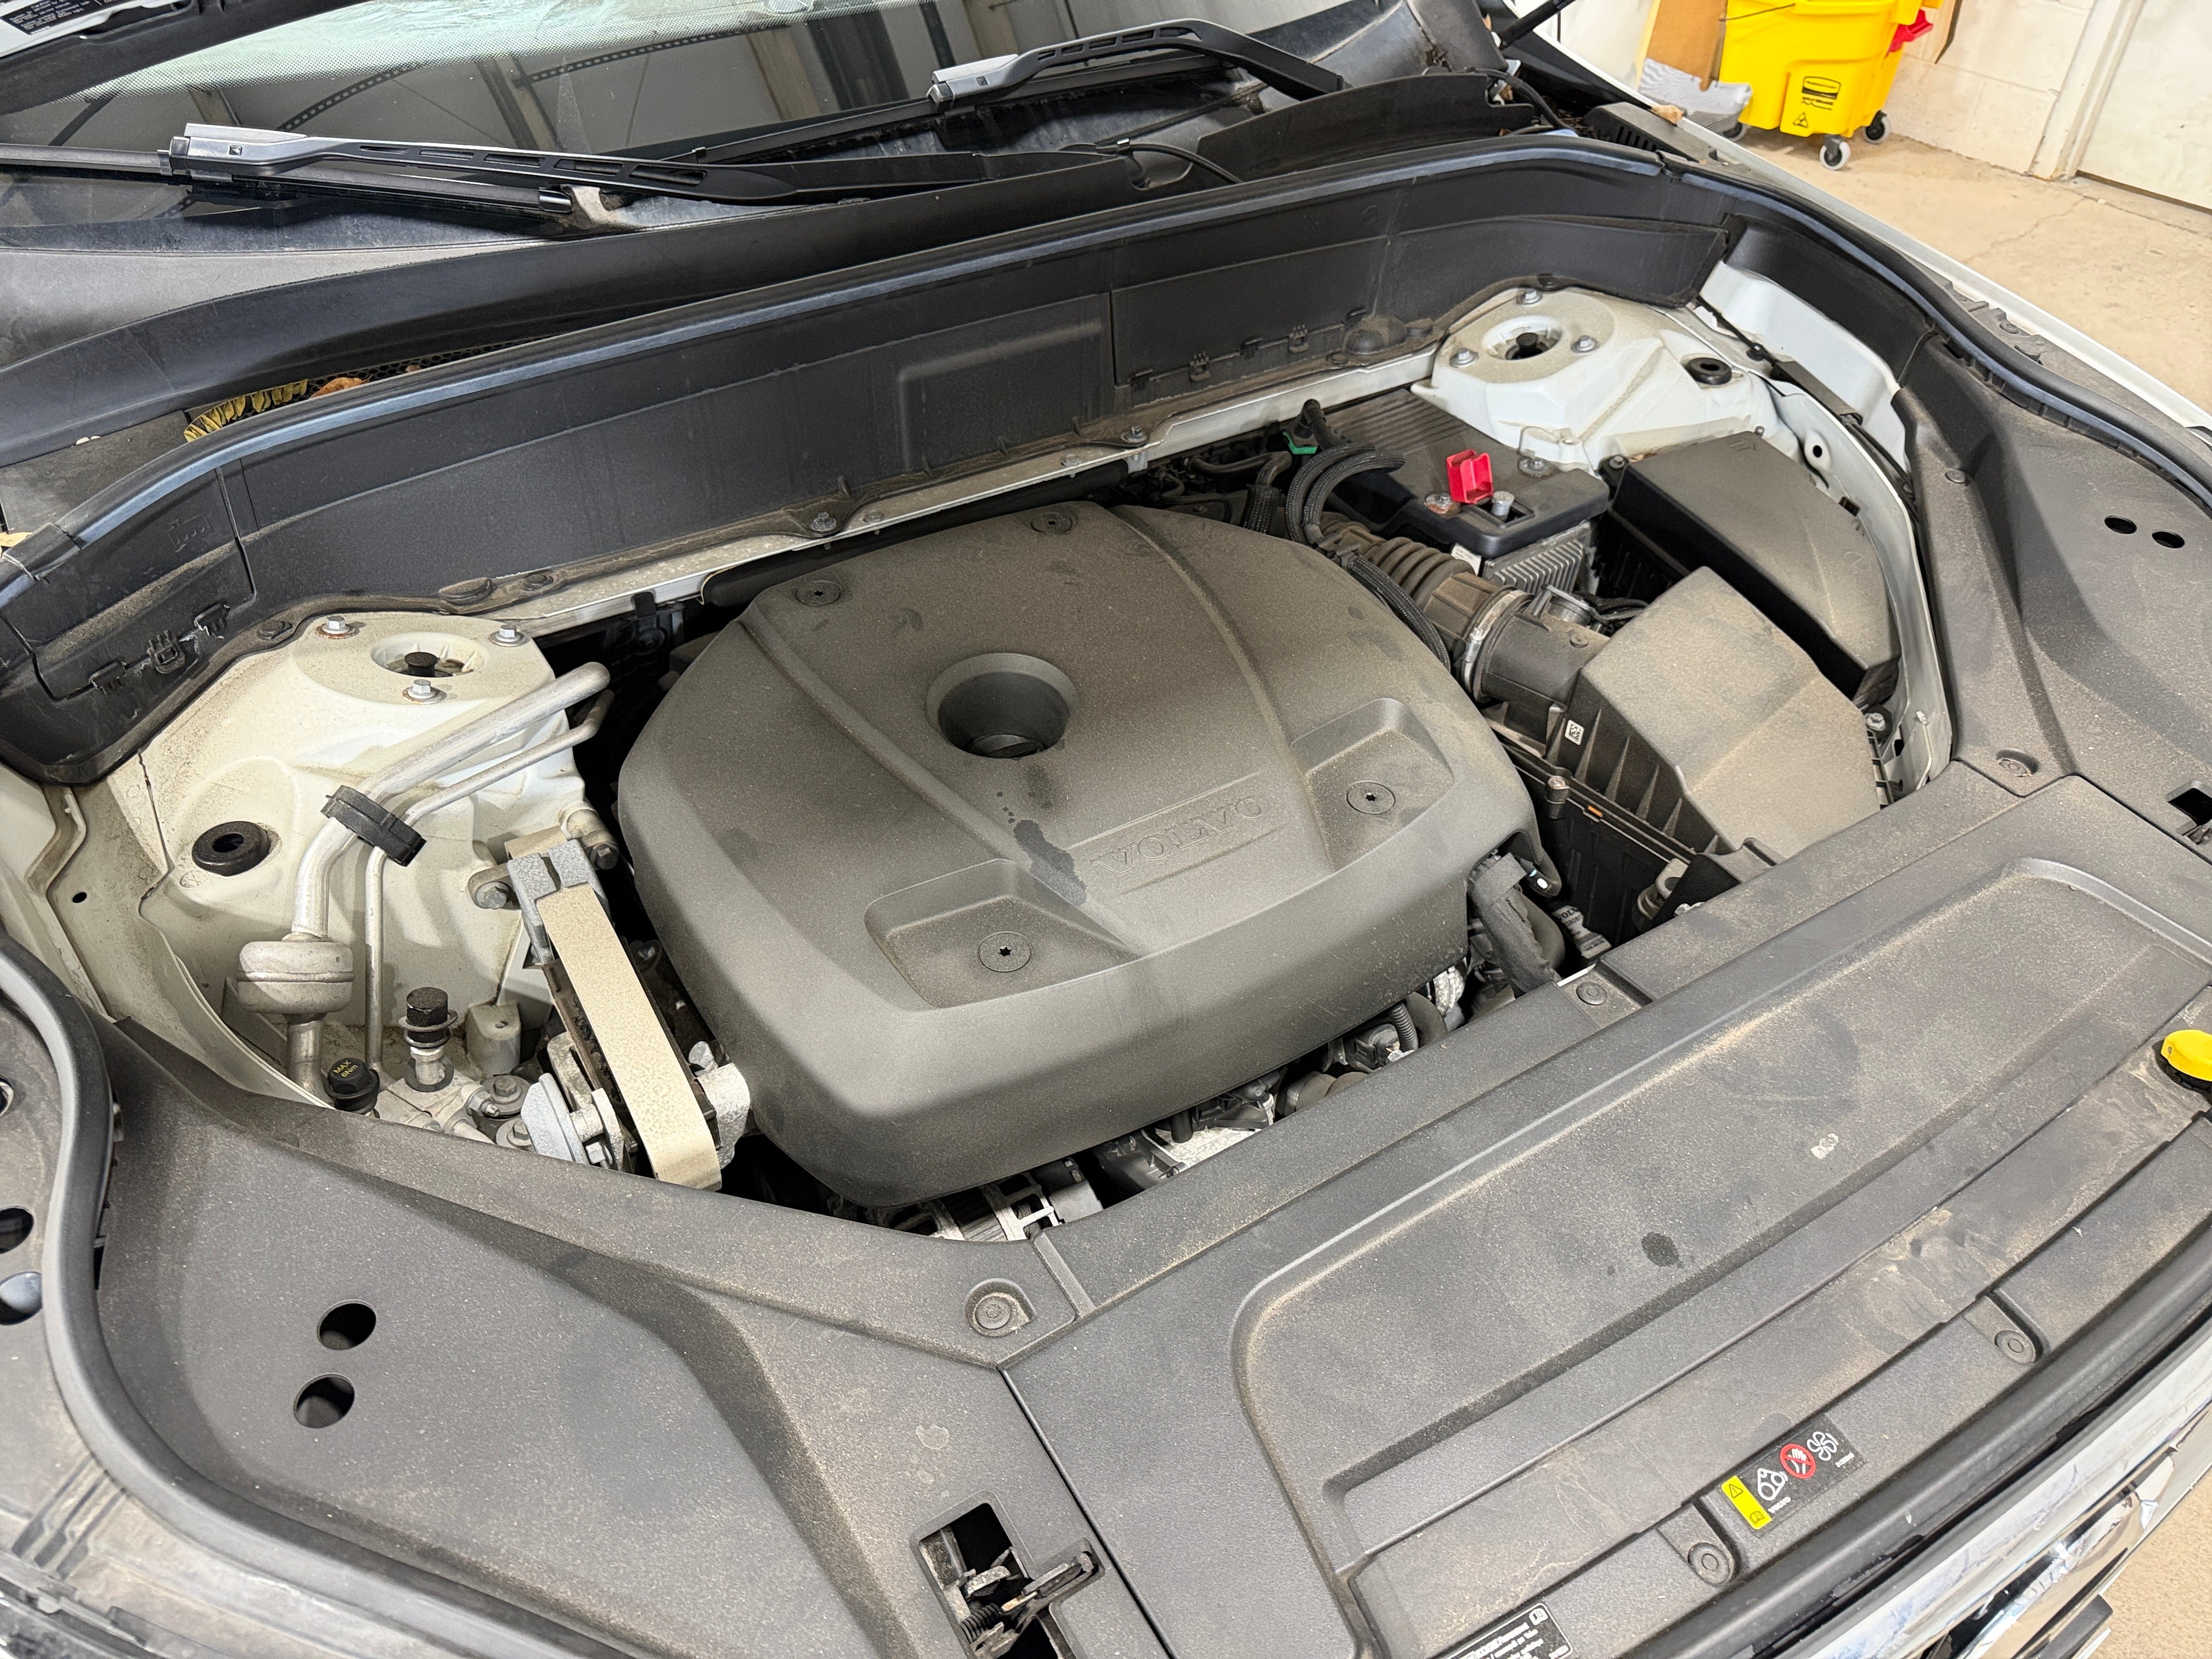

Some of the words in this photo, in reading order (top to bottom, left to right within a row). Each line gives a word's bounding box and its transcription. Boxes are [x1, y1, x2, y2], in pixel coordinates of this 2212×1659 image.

[1088, 796, 1269, 874] VOLVO
[333, 1060, 352, 1074] MAX
[1768, 1496, 1791, 1514] VOLVO
